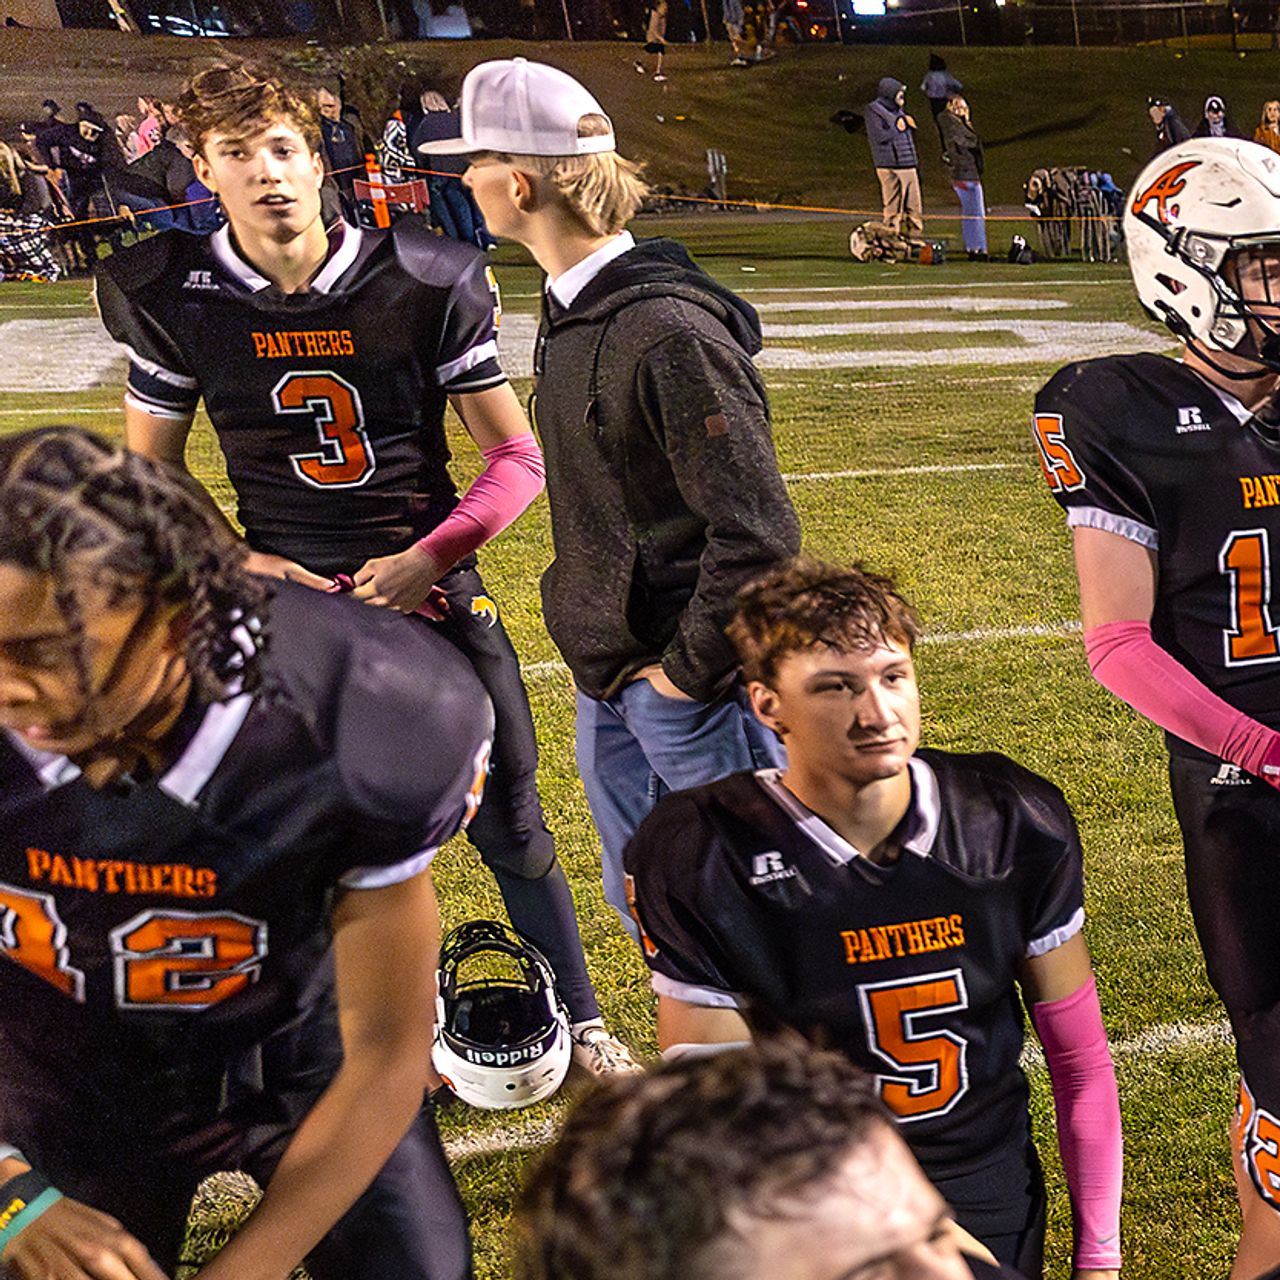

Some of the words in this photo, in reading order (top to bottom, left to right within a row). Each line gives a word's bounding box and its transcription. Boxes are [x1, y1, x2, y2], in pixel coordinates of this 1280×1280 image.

[252, 330, 355, 359] PANTHERS
[270, 370, 376, 489] 3
[26, 847, 219, 899] PANTHERS
[841, 914, 967, 964] PANTHERS
[466, 1041, 544, 1065] Riddell
[855, 968, 969, 1123] 5
